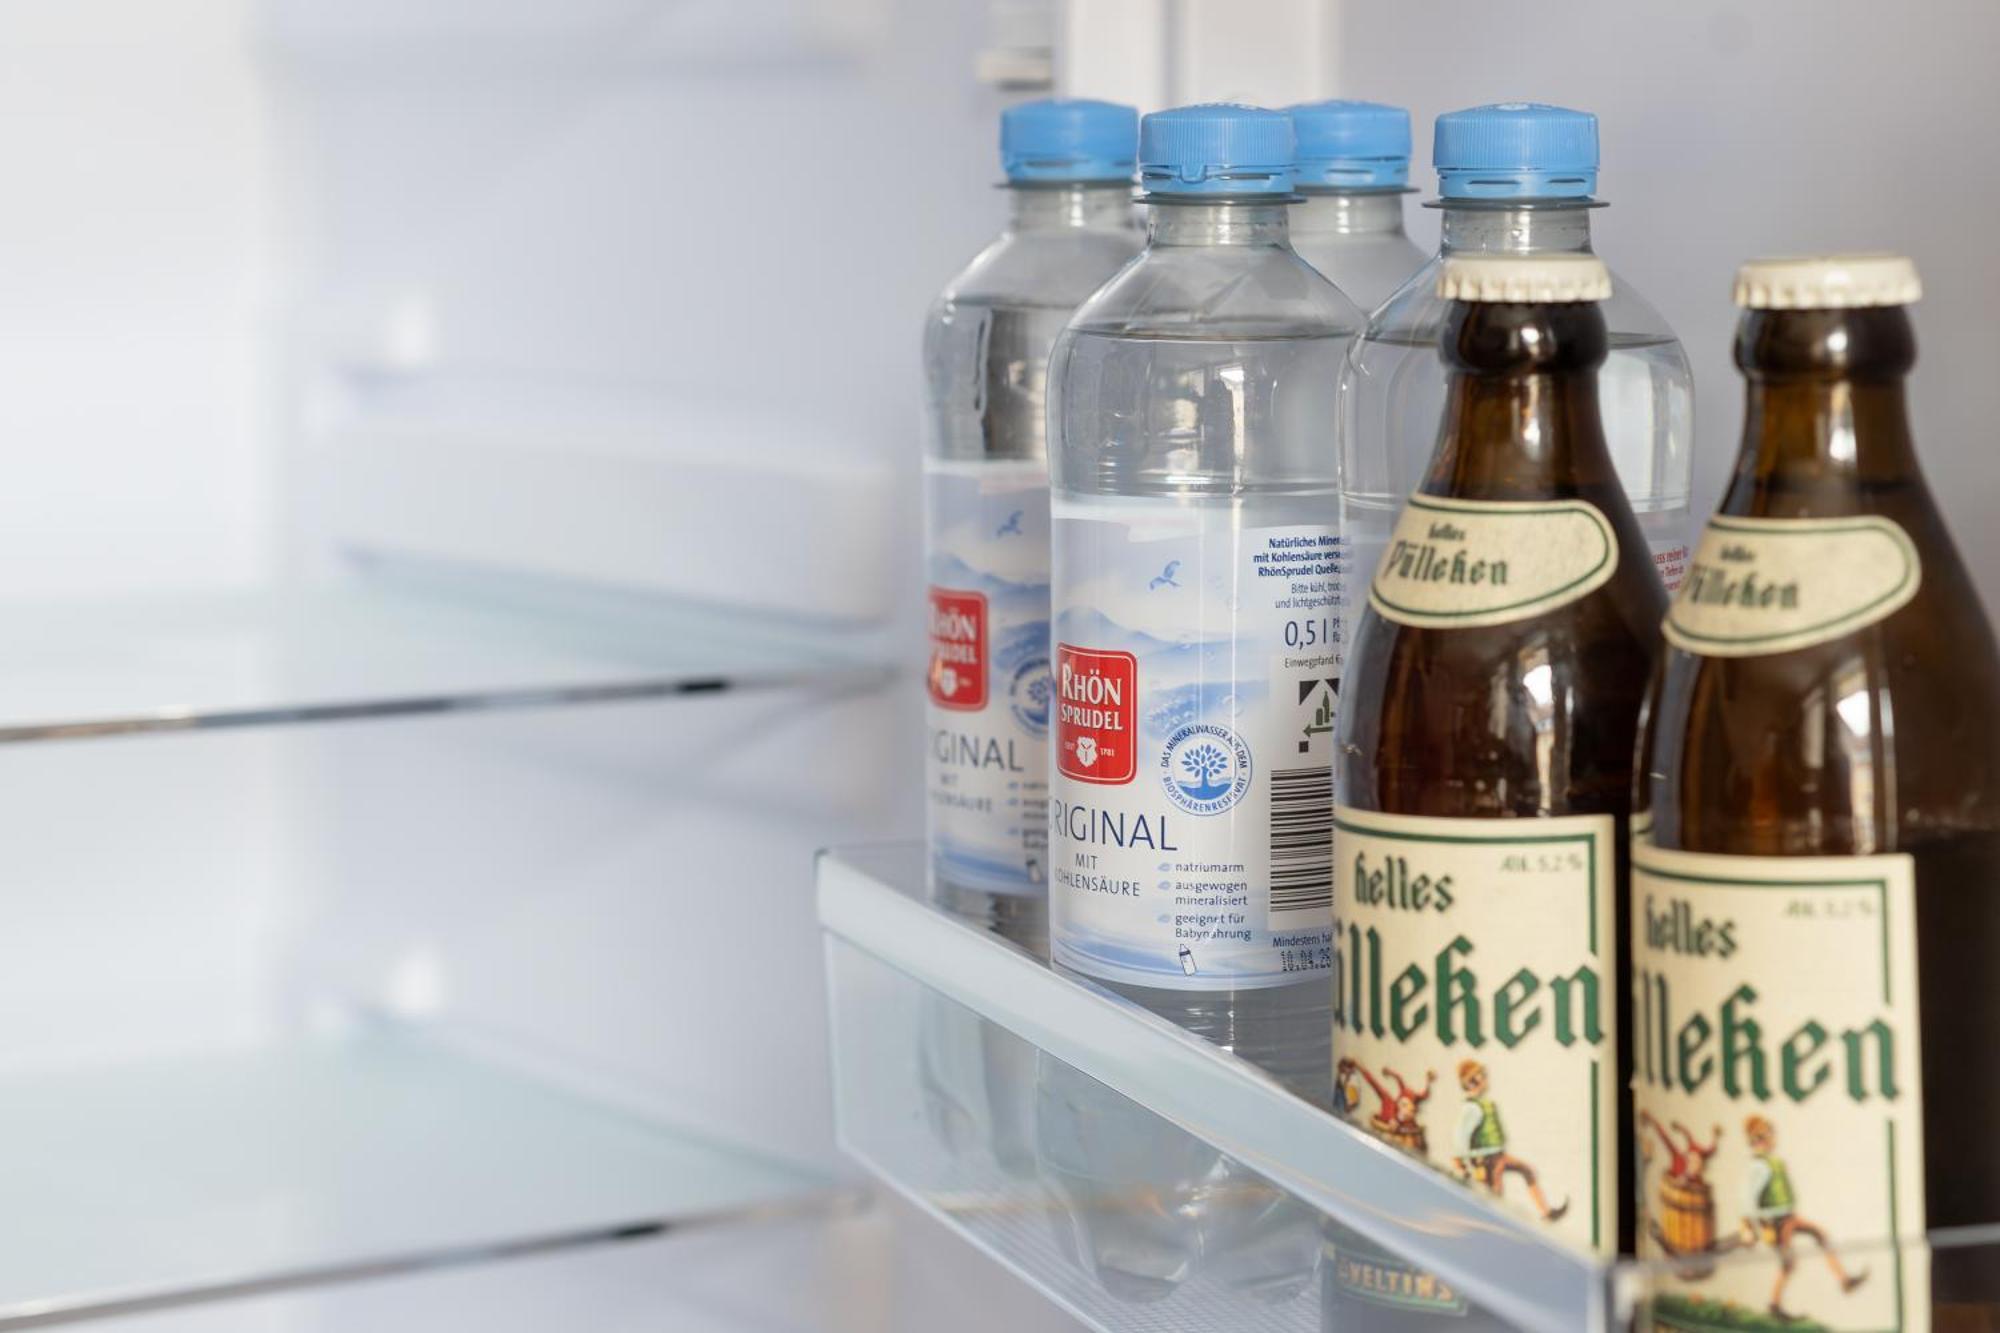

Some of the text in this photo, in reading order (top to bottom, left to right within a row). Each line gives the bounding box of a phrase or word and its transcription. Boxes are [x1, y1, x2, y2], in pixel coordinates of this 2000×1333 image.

[1253, 553, 1270, 563] mit
[1271, 549, 1322, 562] Kohlensäure
[1258, 564, 1314, 579] RhönSprudel
[1284, 620, 1316, 650] 0,5
[1061, 662, 1123, 706] RHÖN
[1061, 703, 1124, 731] SPRUDEL
[1050, 799, 1178, 851] RIGINAL
[1075, 852, 1099, 871] MIT
[1175, 861, 1245, 874] natriumarm
[1055, 867, 1141, 897] OHLENSÄURE
[1175, 881, 1248, 894] ausgewogen
[1175, 895, 1249, 907] mineralisiert
[1228, 913, 1246, 925] für
